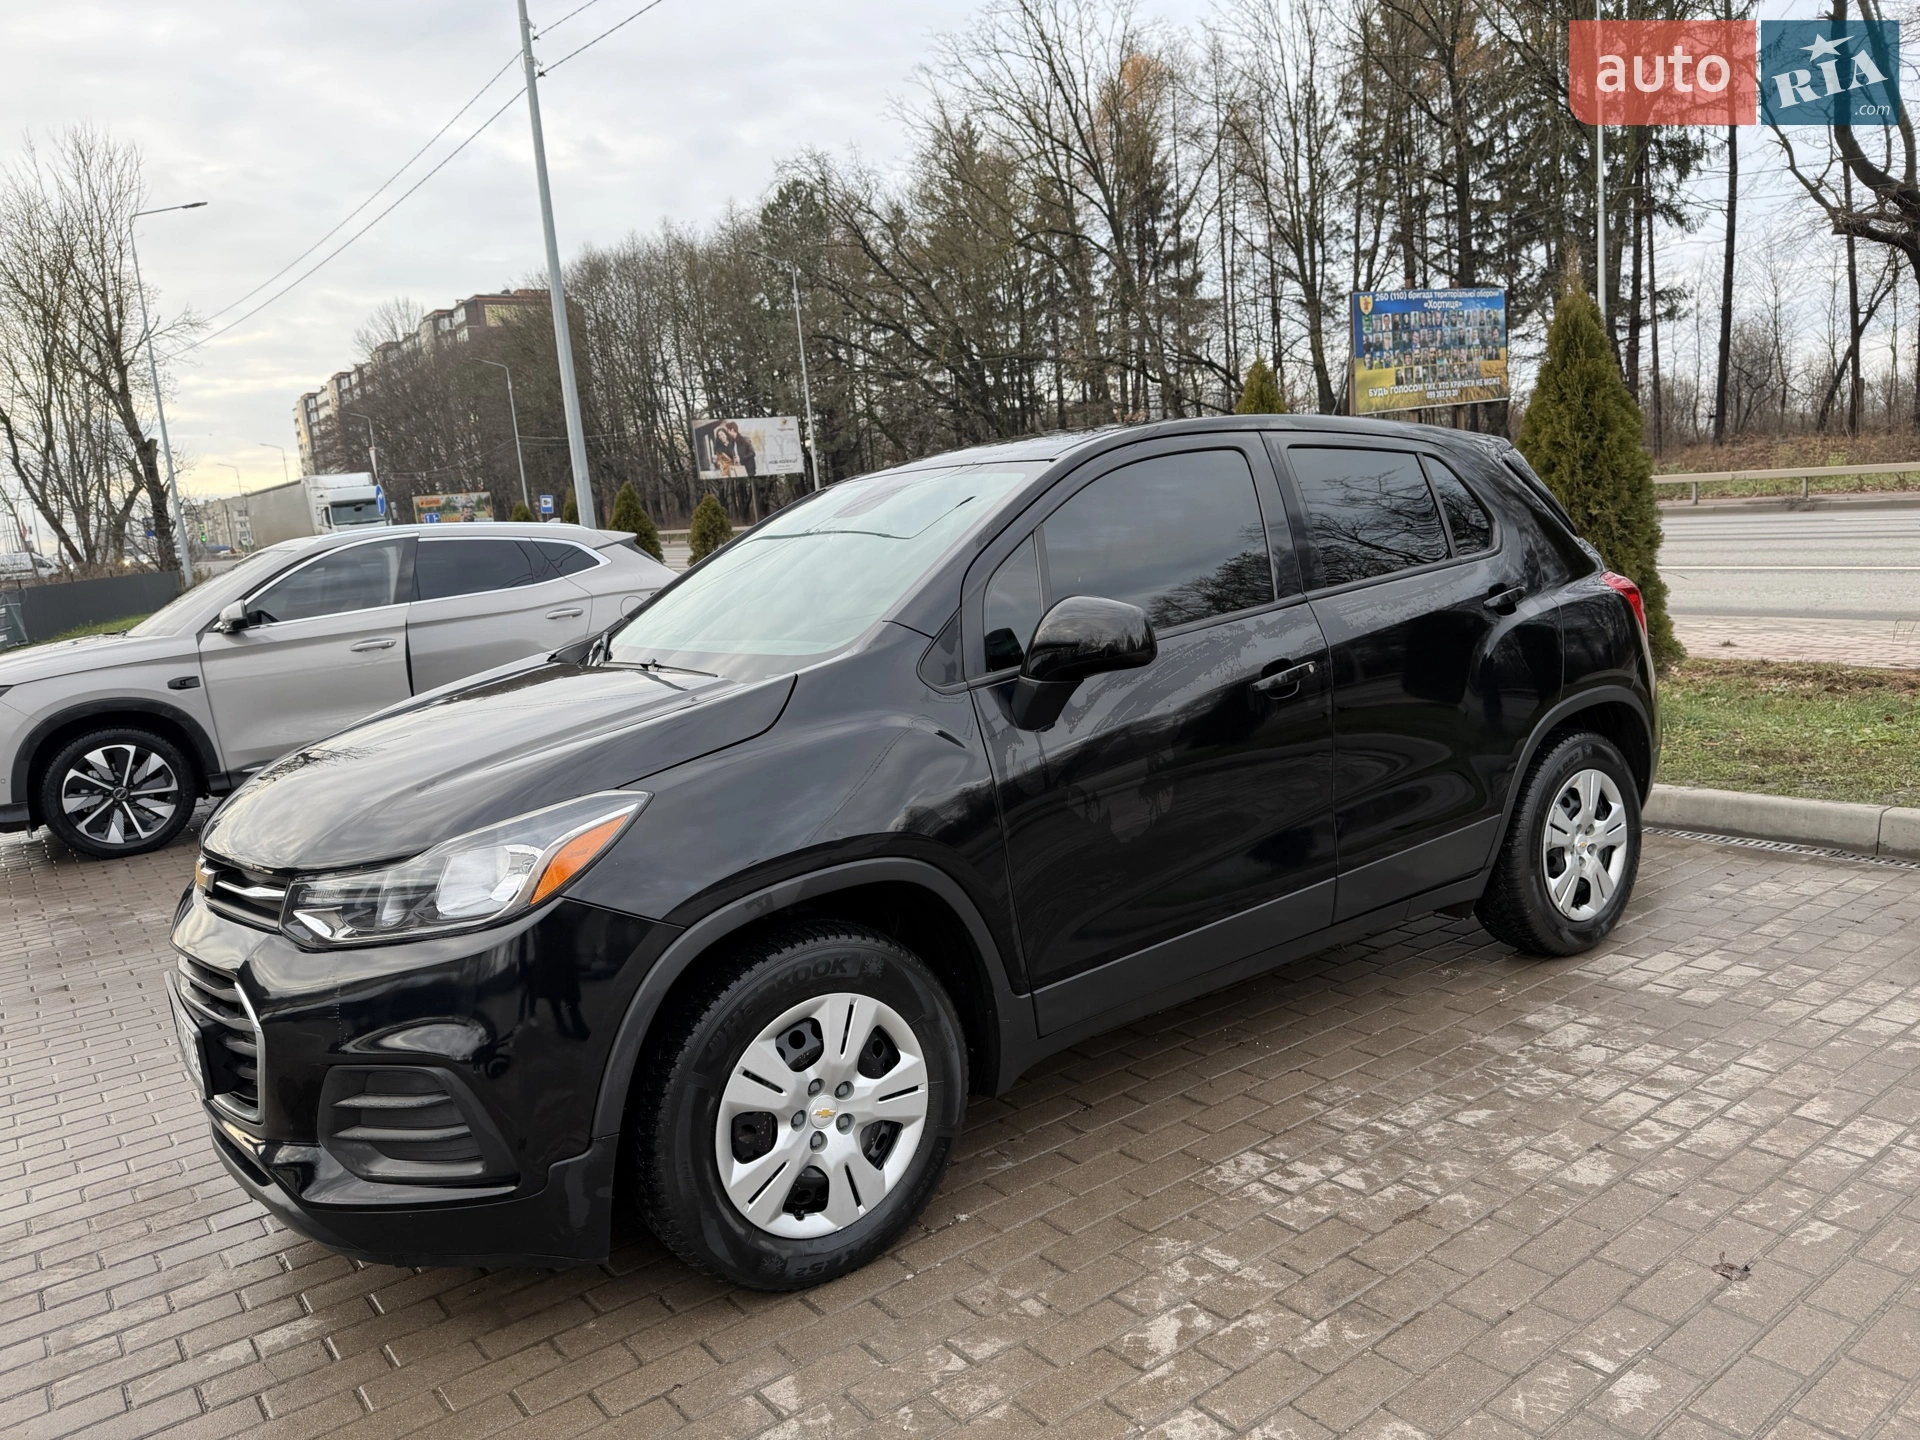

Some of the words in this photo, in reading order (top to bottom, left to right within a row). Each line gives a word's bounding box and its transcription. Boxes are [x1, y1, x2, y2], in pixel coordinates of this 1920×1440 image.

[1375, 293, 1389, 301] 260
[1390, 292, 1407, 301] (110)
[1408, 291, 1433, 300] бригада
[1423, 299, 1463, 310] «Хортиця»
[1368, 388, 1388, 397] БУДЬ
[1390, 383, 1423, 394] ГОЛОСОМ
